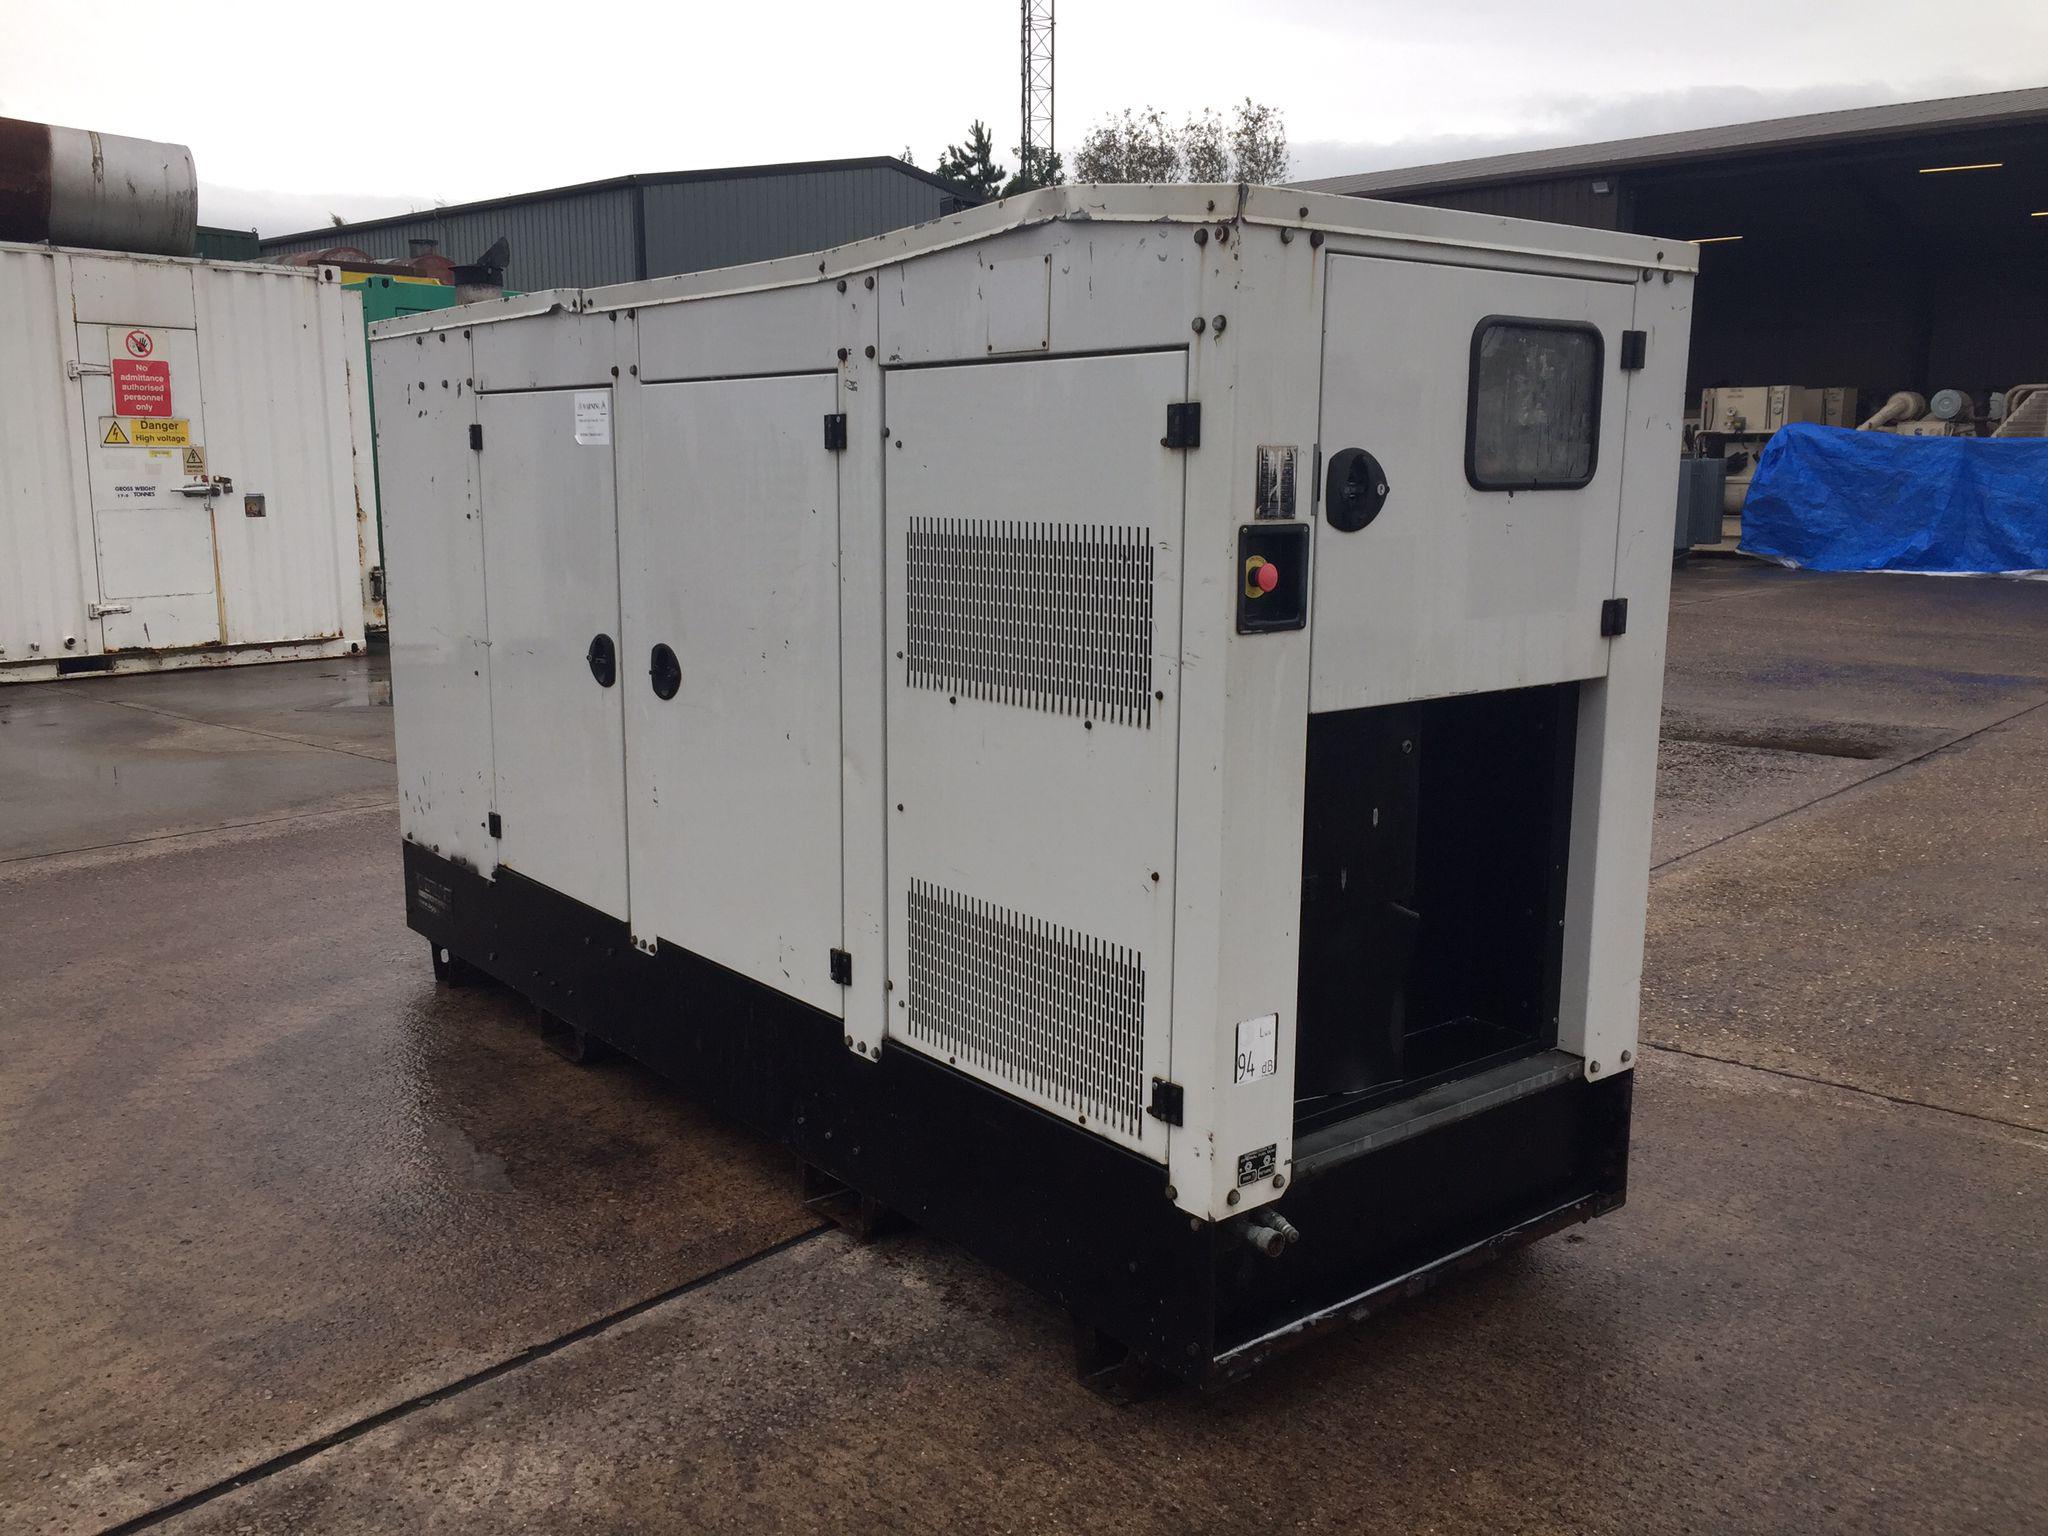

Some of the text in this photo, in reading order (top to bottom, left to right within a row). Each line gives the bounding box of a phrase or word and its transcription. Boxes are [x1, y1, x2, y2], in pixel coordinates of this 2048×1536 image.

[136, 364, 148, 372] No
[120, 374, 164, 382] admittance
[122, 384, 164, 392] authorised
[124, 394, 164, 402] personnel
[136, 404, 153, 412] only
[140, 420, 179, 432] Danger
[136, 434, 186, 443] High voltage
[1238, 1050, 1273, 1081] 94 dB
